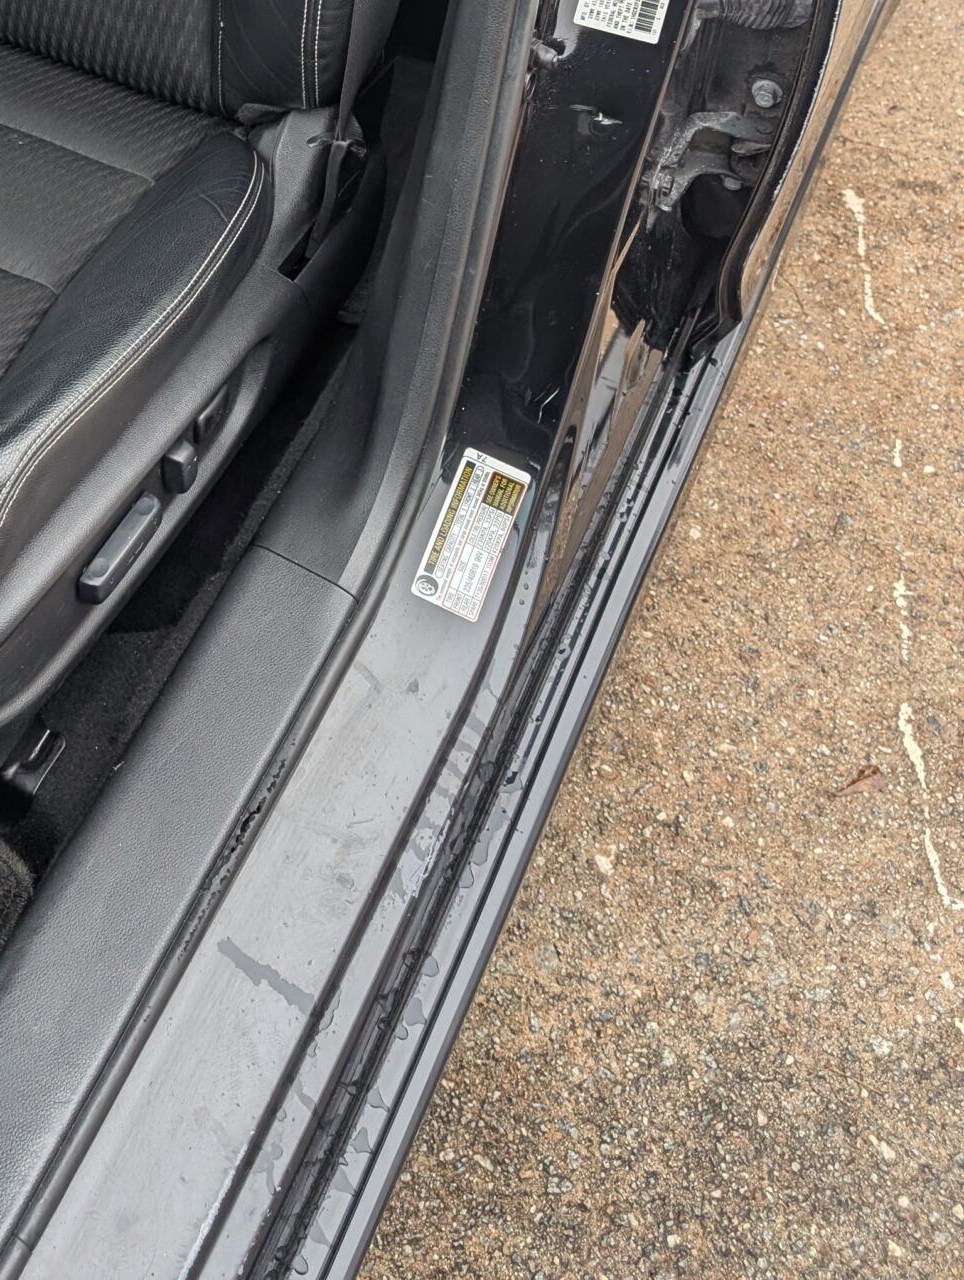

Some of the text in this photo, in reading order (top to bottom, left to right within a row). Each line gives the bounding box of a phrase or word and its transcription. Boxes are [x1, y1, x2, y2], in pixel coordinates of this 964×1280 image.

[616, 5, 624, 19] THEFT
[624, 1, 633, 13] DATE
[606, 8, 616, 28] FEDERAL
[476, 452, 488, 464] 7A
[484, 474, 502, 504] SEE OWNER'S
[491, 477, 508, 507] MANUAL FOR
[498, 480, 515, 511] ADDITIONAL
[505, 483, 522, 514] INFORMATION
[427, 465, 473, 566] TIRE AND LOADING INFORMATION
[437, 553, 449, 573] SEATING
[444, 531, 458, 554] CAPACITY
[463, 491, 473, 505] FRONT
[472, 472, 482, 484] REAR
[468, 504, 488, 544] COLD TIRE PRESSURE
[457, 559, 466, 572] SIZE
[445, 591, 454, 604] TIRE
[451, 592, 463, 610] FRONT
[460, 596, 470, 612] REAR
[467, 600, 478, 617] SPARE
